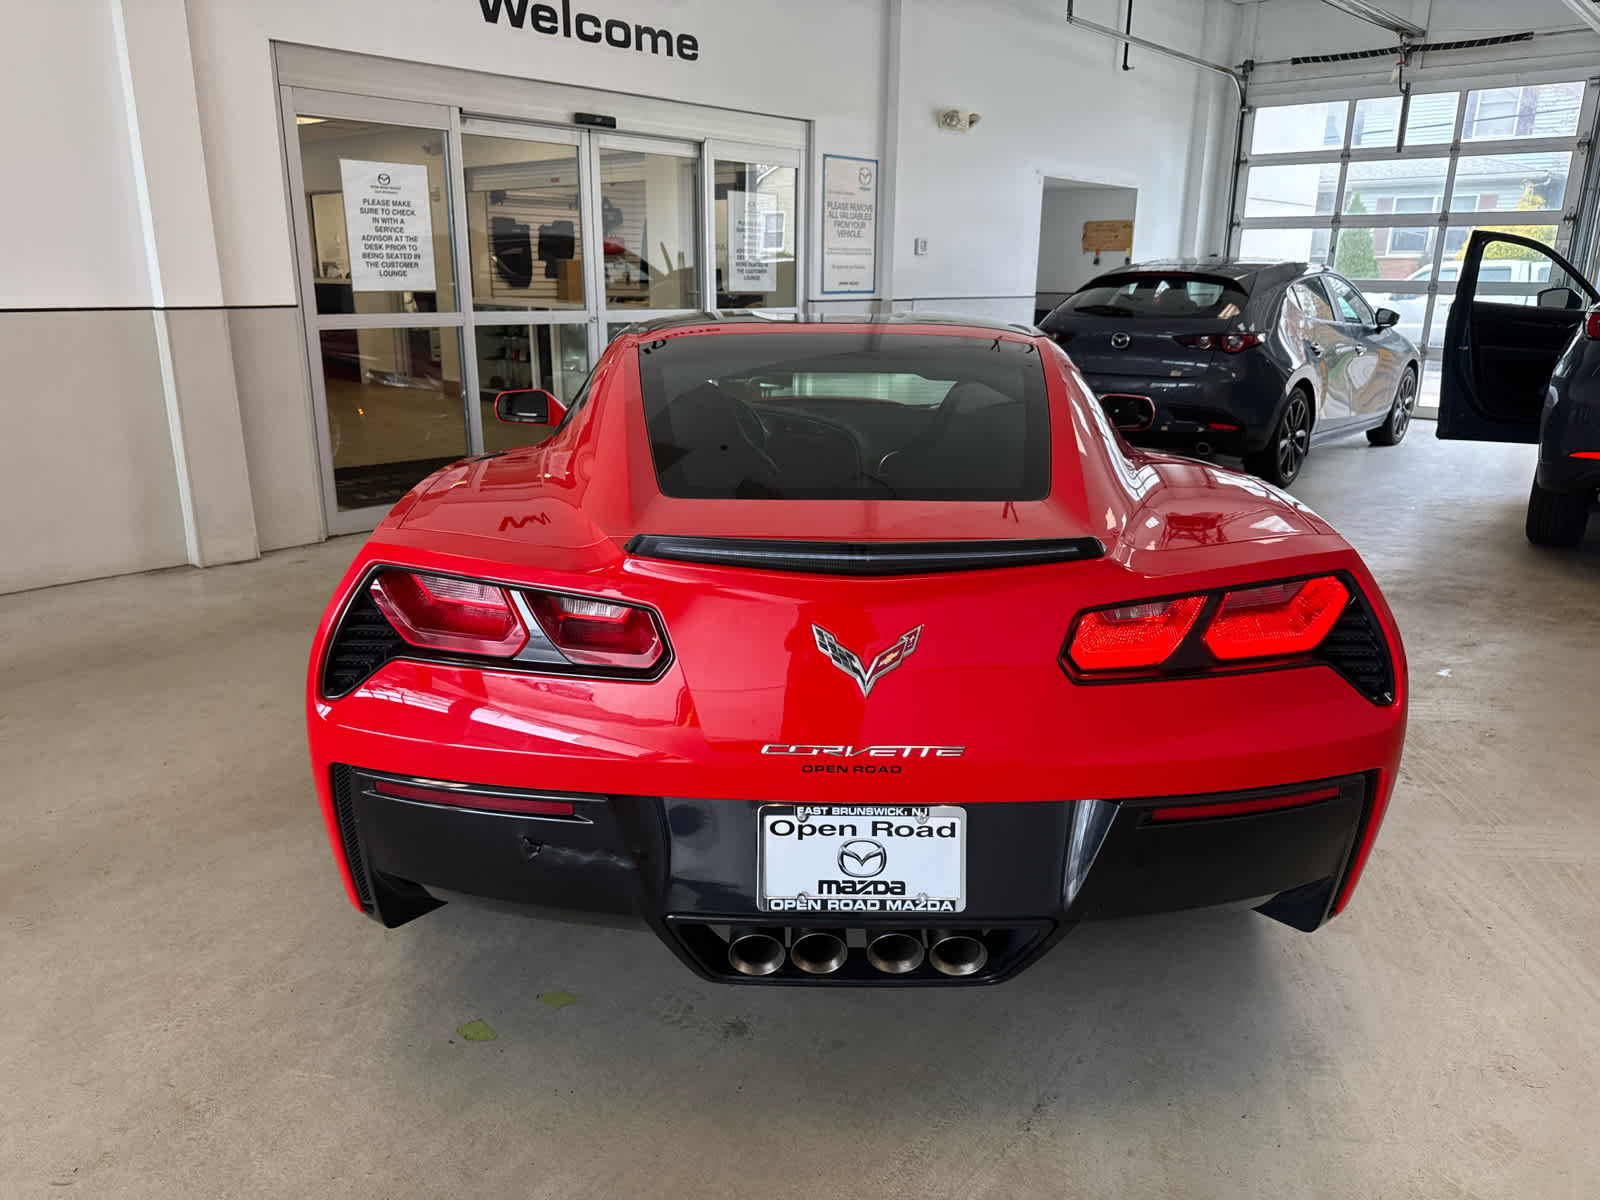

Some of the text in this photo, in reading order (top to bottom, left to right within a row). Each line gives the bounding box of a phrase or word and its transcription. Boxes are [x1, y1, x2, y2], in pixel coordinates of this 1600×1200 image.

[478, 0, 699, 61] Welcome
[363, 199, 390, 207] PLEASE
[381, 208, 390, 216] TO
[760, 744, 966, 758] CORVETTE
[801, 765, 902, 774] OPEN ROAD
[796, 807, 928, 817] EAST BRUNSWICK, NJ
[769, 819, 956, 840] Open Road
[770, 899, 954, 911] OPEN ROAD MAZDA
